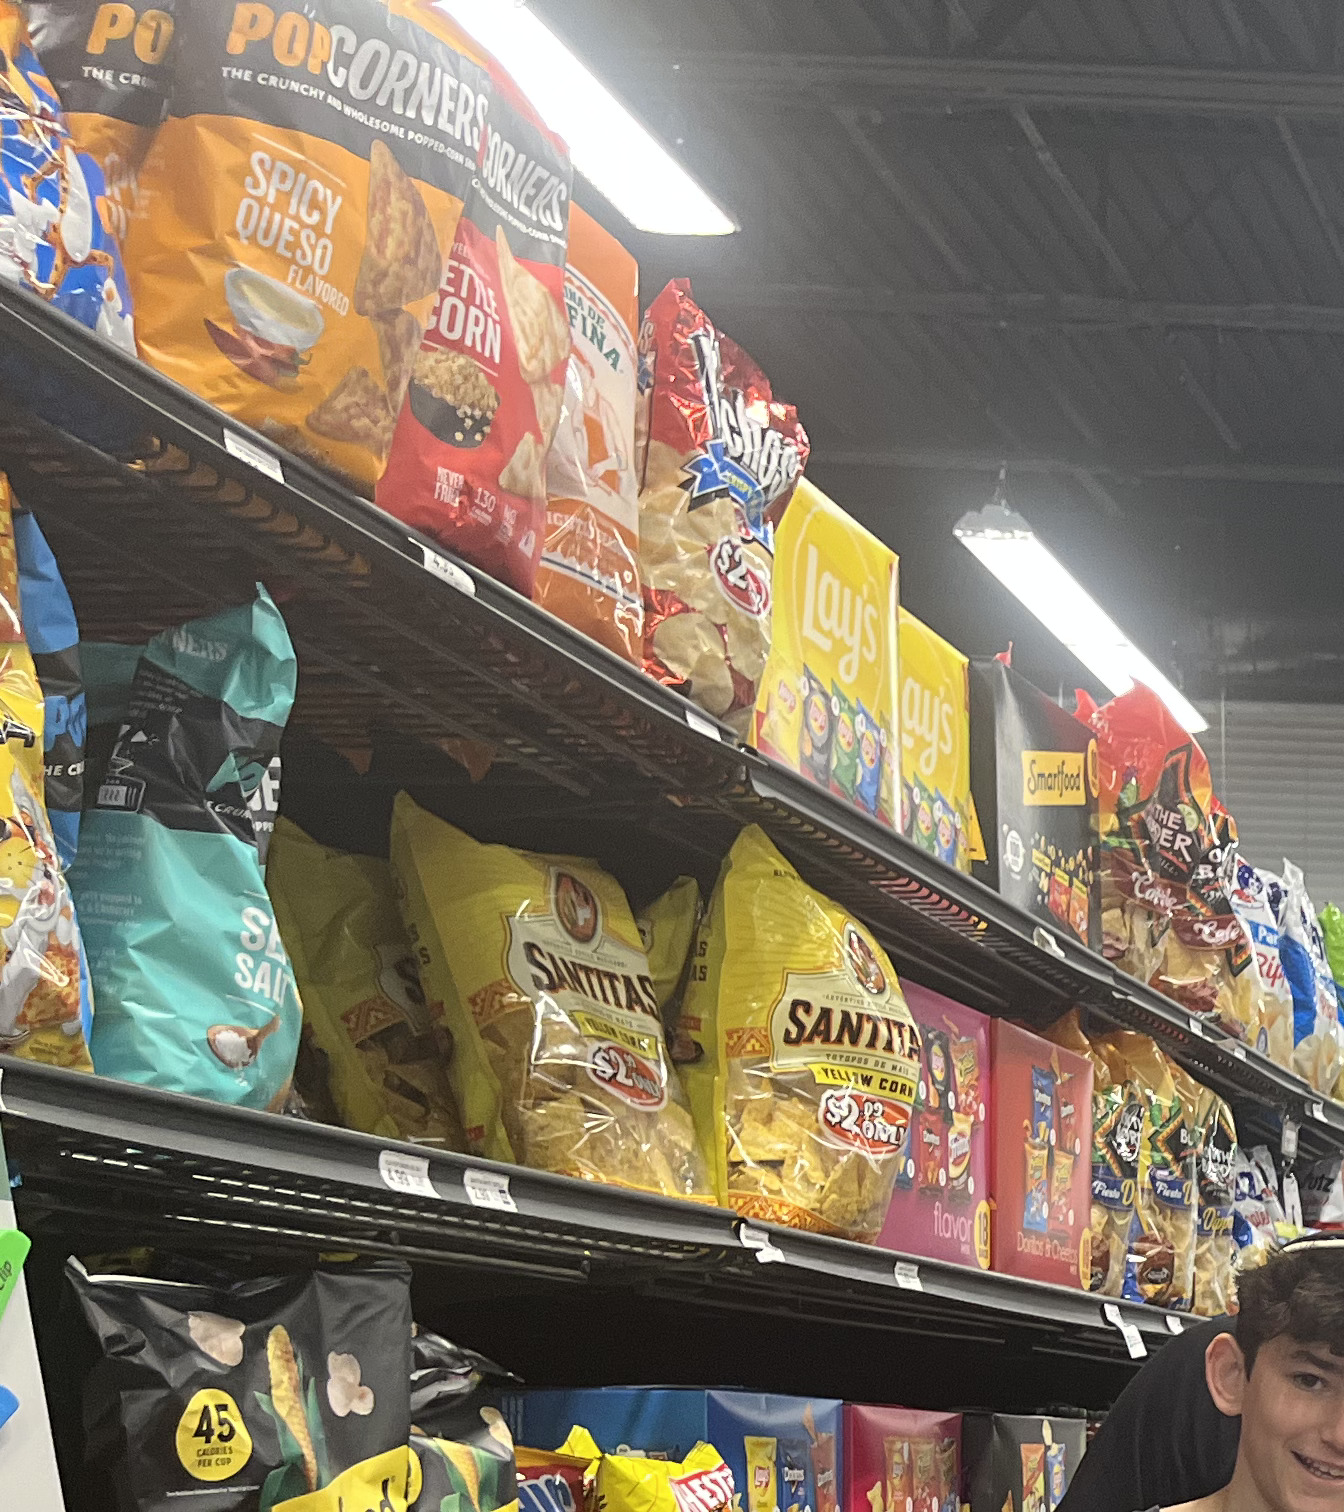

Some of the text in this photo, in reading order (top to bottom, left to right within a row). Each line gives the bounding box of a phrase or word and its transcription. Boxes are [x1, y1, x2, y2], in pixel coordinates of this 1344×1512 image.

[222, 66, 253, 83] THE
[257, 72, 325, 101] CRUNCHY
[246, 151, 342, 237] SPICY
[235, 198, 334, 277] QUESO
[287, 268, 349, 318] FLAVORED
[802, 544, 878, 682] Lay's
[1027, 757, 1081, 796] Smartfood
[783, 999, 921, 1061] SANTITA
[821, 1067, 913, 1098] YELLOW CORN
[933, 1202, 973, 1239] flavor
[193, 1404, 236, 1445] 45
